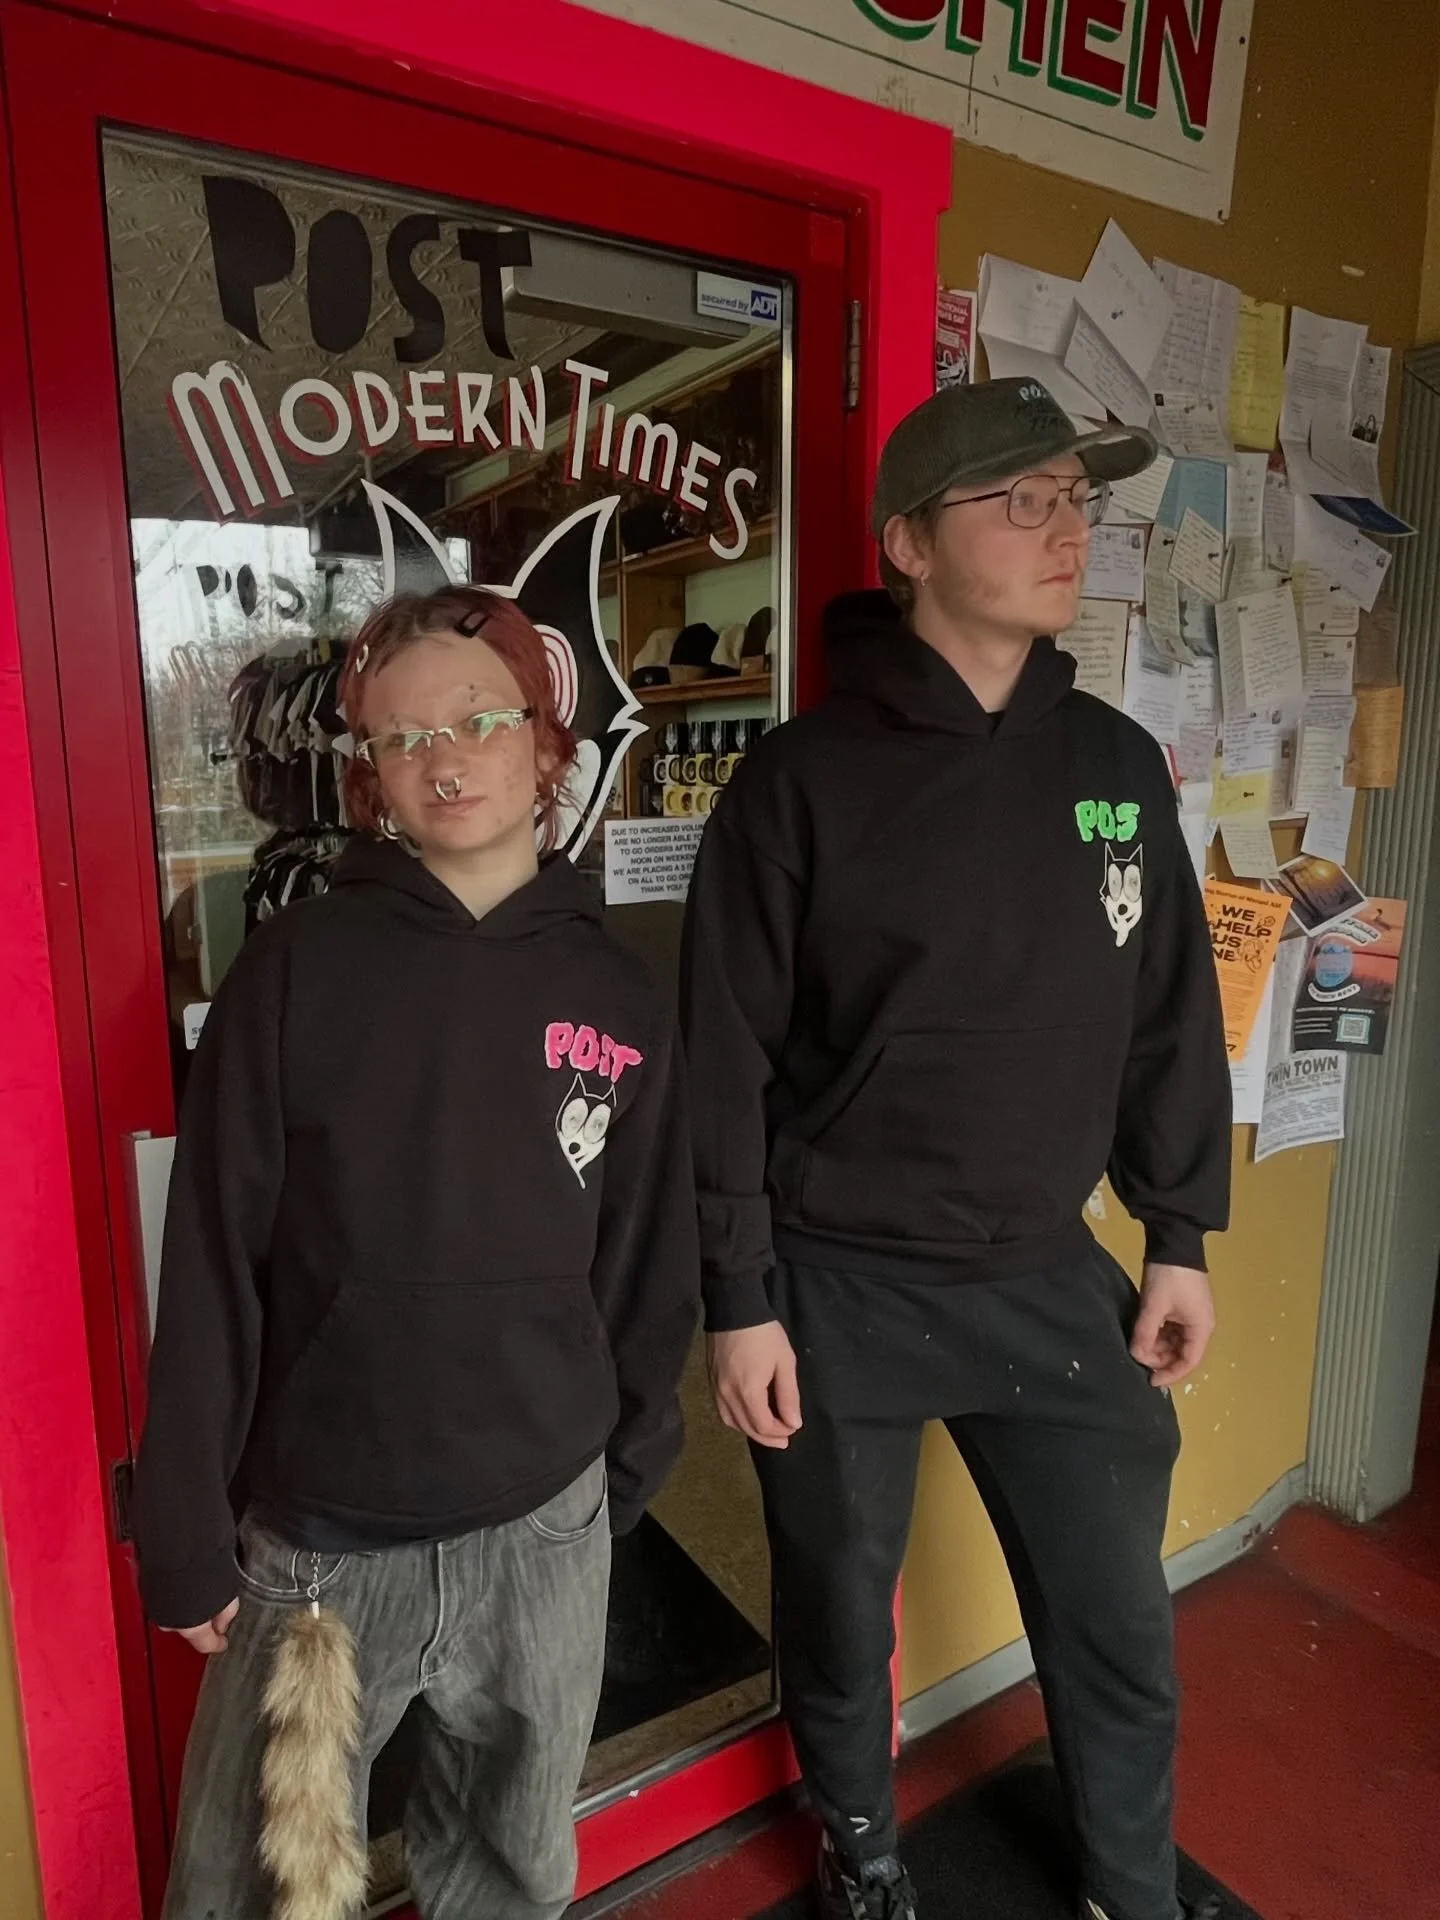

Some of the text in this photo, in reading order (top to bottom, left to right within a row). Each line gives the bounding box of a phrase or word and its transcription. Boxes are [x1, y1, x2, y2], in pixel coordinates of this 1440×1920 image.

[201, 174, 532, 363] POST
[702, 294, 776, 317] secured by ADT
[167, 358, 757, 560] MODERN TIMES
[611, 824, 704, 836] DUE TO INCREASED VOLUM
[630, 837, 641, 845] NO
[643, 835, 671, 844] LONGER
[673, 834, 691, 842] ABLE
[632, 847, 643, 855] GO
[644, 845, 673, 854] ORDERS
[675, 844, 697, 852] AFTER
[626, 867, 640, 875] ARE
[642, 865, 672, 874] PLACING
[640, 885, 664, 893] THANK
[1222, 904, 1256, 921] WE
[1214, 918, 1272, 938] HELP
[1294, 1055, 1338, 1077] TOWN
